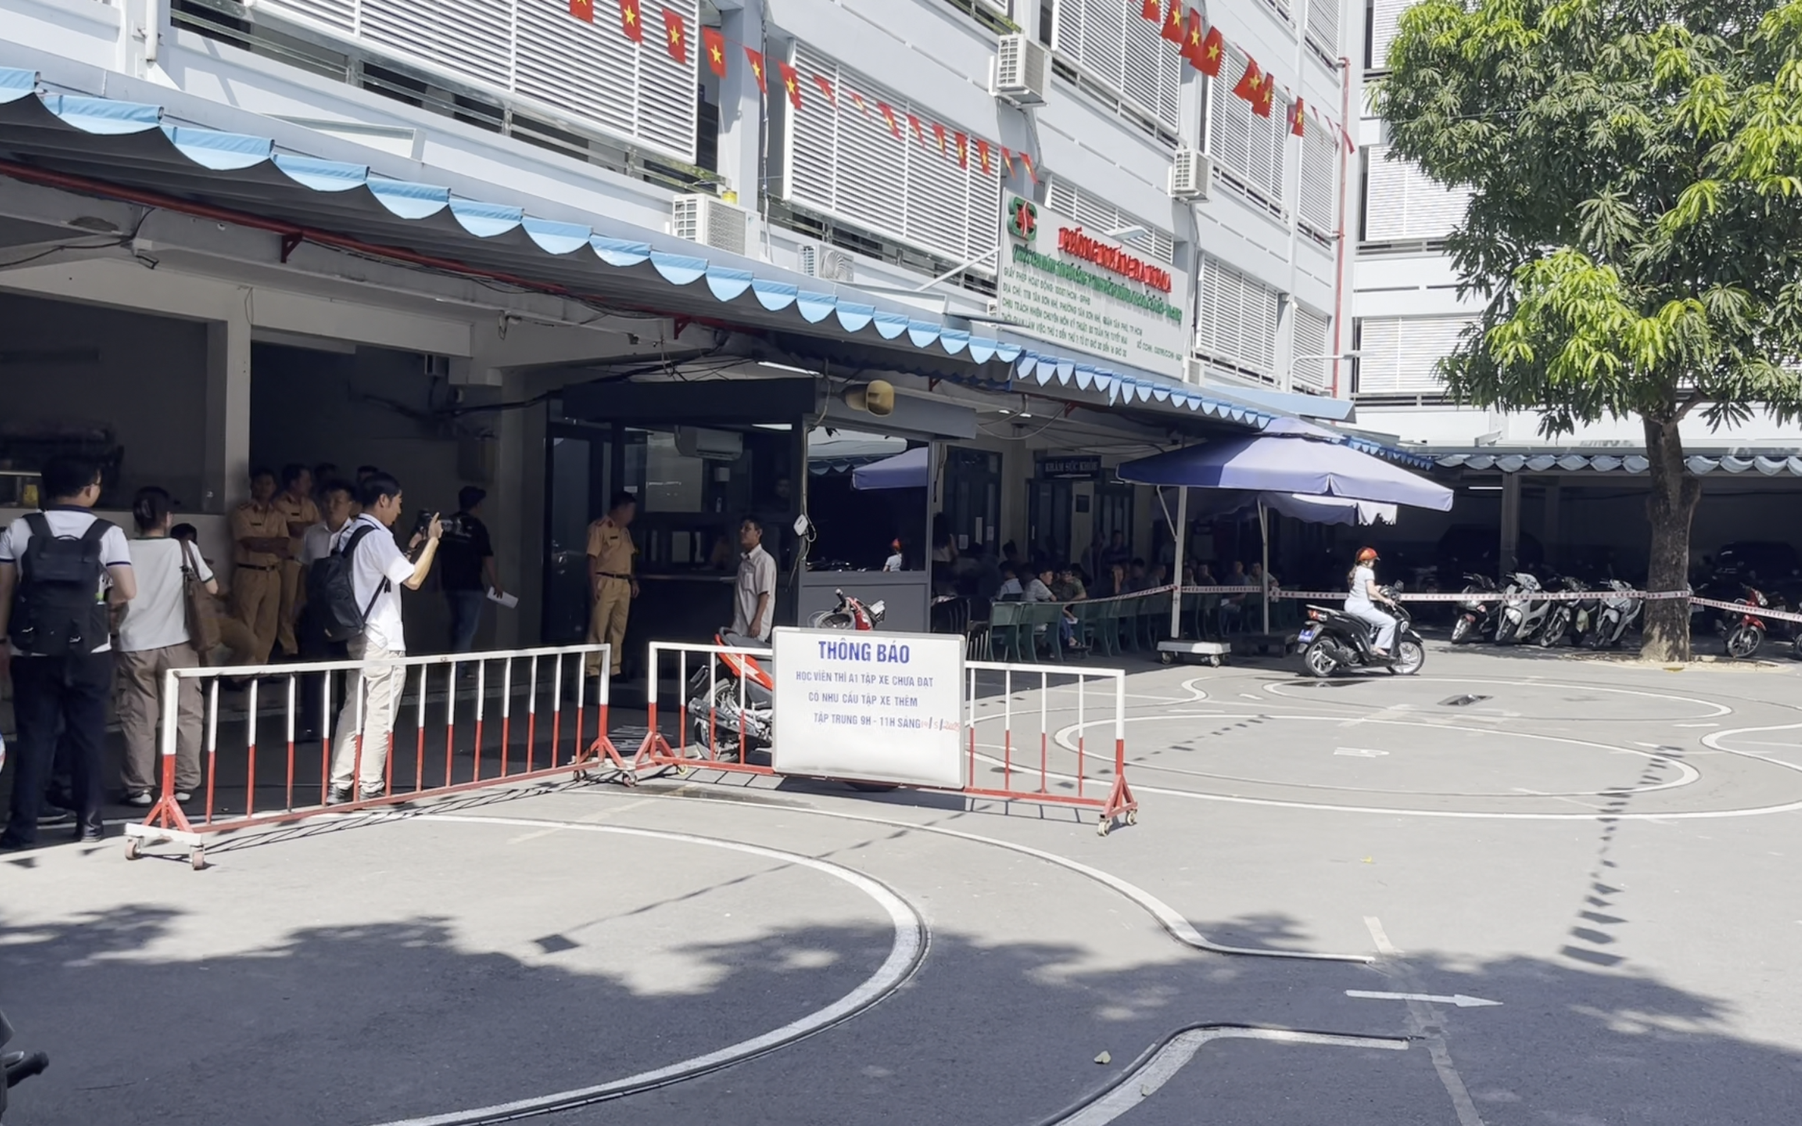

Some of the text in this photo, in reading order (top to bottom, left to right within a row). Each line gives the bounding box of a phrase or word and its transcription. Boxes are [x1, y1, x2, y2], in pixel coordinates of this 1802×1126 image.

[818, 637, 910, 664] THÔNG BÁO
[796, 670, 812, 683] HỌC
[848, 673, 858, 683] A1
[861, 672, 876, 686] TẬP
[879, 674, 889, 685] XE
[892, 675, 915, 687] CHƯA
[917, 676, 934, 689] ĐẠT
[822, 692, 839, 703] NHU
[861, 693, 877, 707] TẬP
[880, 695, 891, 706] XE
[894, 695, 918, 707] THÊM
[814, 711, 829, 725] TẬP
[831, 714, 858, 725] TRUNG
[860, 715, 871, 726] 9H
[879, 716, 895, 727] 11H
